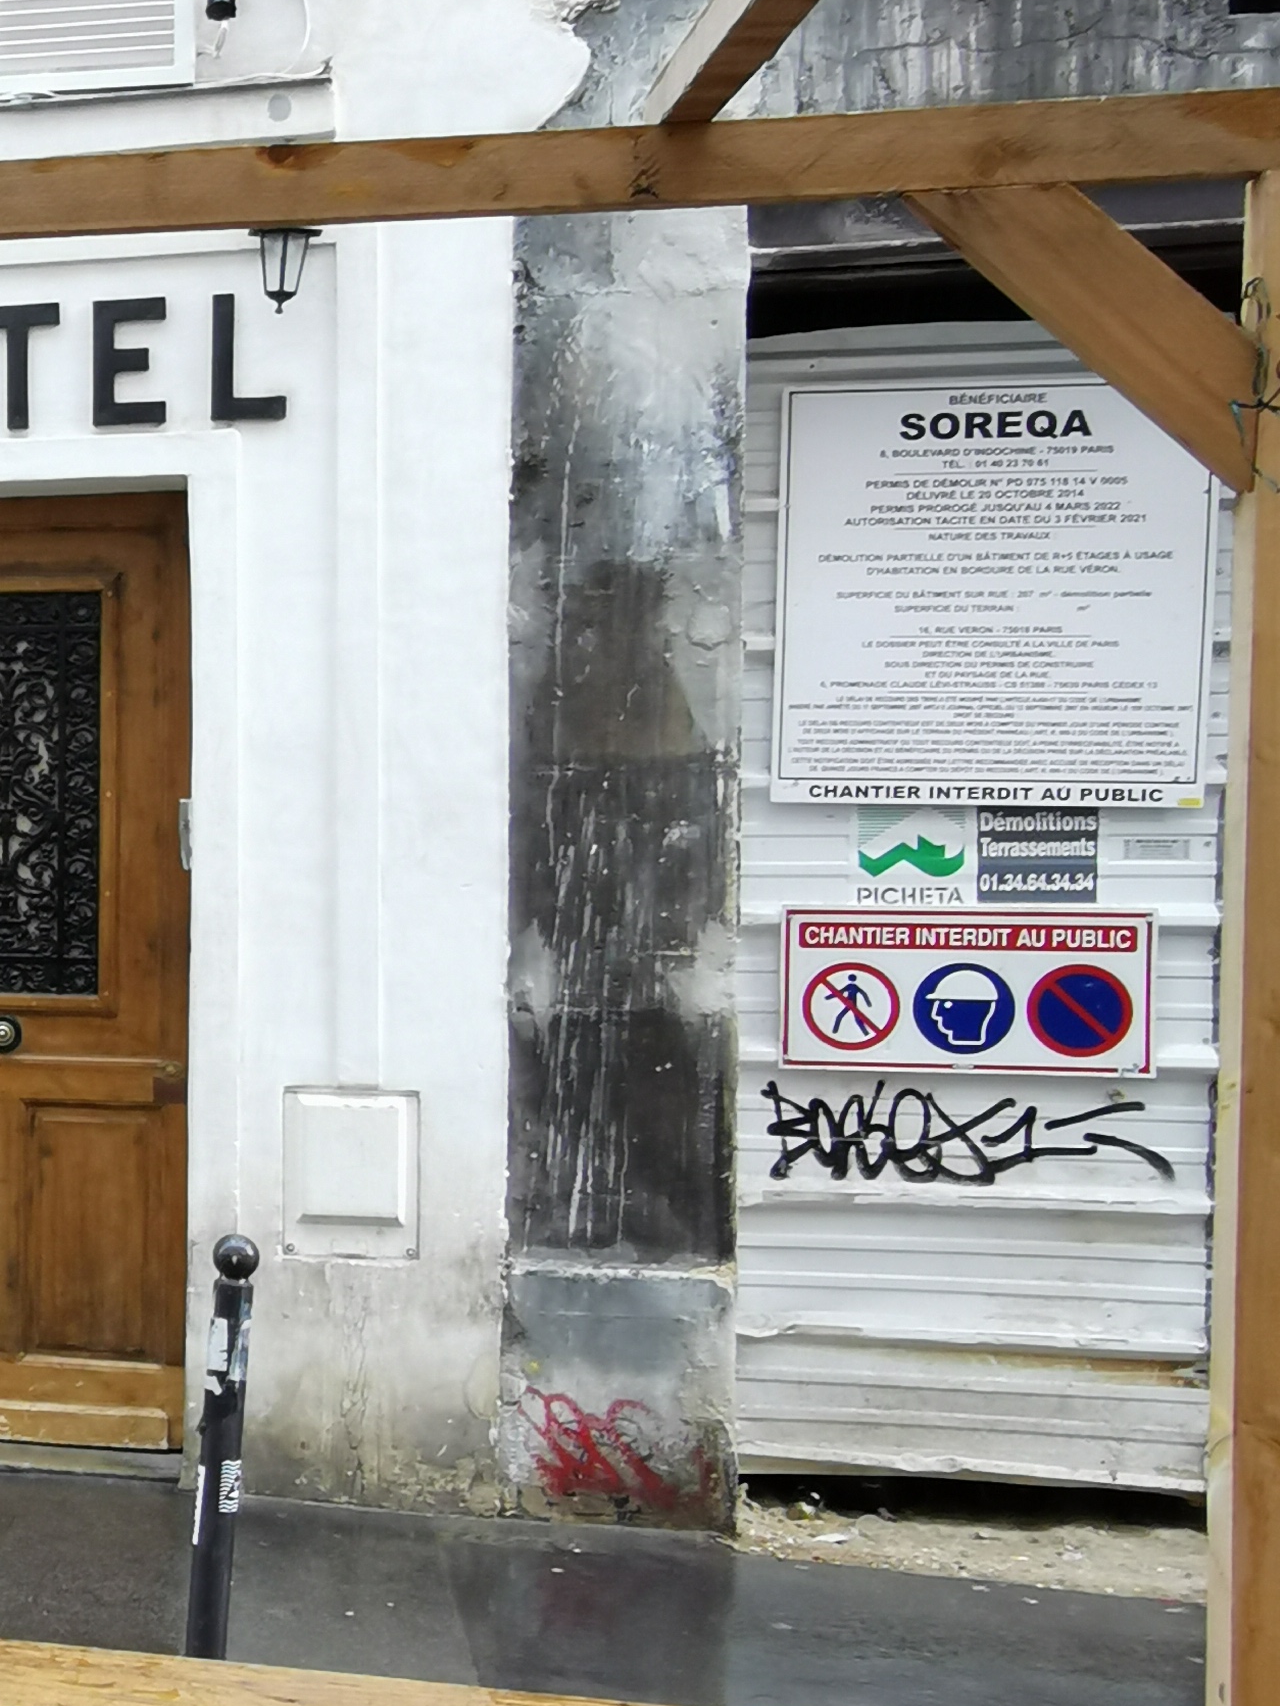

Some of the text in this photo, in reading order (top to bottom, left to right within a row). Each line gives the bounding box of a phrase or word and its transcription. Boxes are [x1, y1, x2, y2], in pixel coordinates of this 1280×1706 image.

[949, 392, 1048, 405] BÉNÉFICIAIRE
[899, 409, 1093, 440] SOREQA
[892, 447, 960, 458] BOULEVARD
[913, 480, 930, 488] DE
[933, 478, 987, 488] DÉMOLIR
[906, 490, 956, 500] DÉLIVRÉ
[960, 491, 976, 500] LE
[994, 489, 1054, 499] OCTOBRE
[1055, 502, 1091, 511] MARS
[844, 517, 931, 526] AUTORISATION
[935, 516, 976, 526] TACITE
[980, 516, 995, 524] EN
[999, 515, 1031, 524] DATE
[1034, 515, 1051, 524] DU
[1064, 513, 1117, 523] FÉVRIER
[928, 532, 1051, 541] NATURE DES TRAVAUX
[1034, 552, 1050, 560] DE
[943, 566, 957, 575] EN
[1018, 566, 1032, 574] DE
[1035, 566, 1051, 574] LA
[1053, 565, 1076, 574] RUE
[809, 784, 1164, 802] CHANTIER INTERDIT AU PUBLIC
[979, 811, 1097, 832] Démolitions
[980, 837, 1096, 859] Terrassements
[979, 873, 1094, 892] 01.34.64.34.34
[856, 887, 964, 905] PICHETA
[804, 926, 1133, 949] CHANTIER INTERDIT AU PUBLIC
